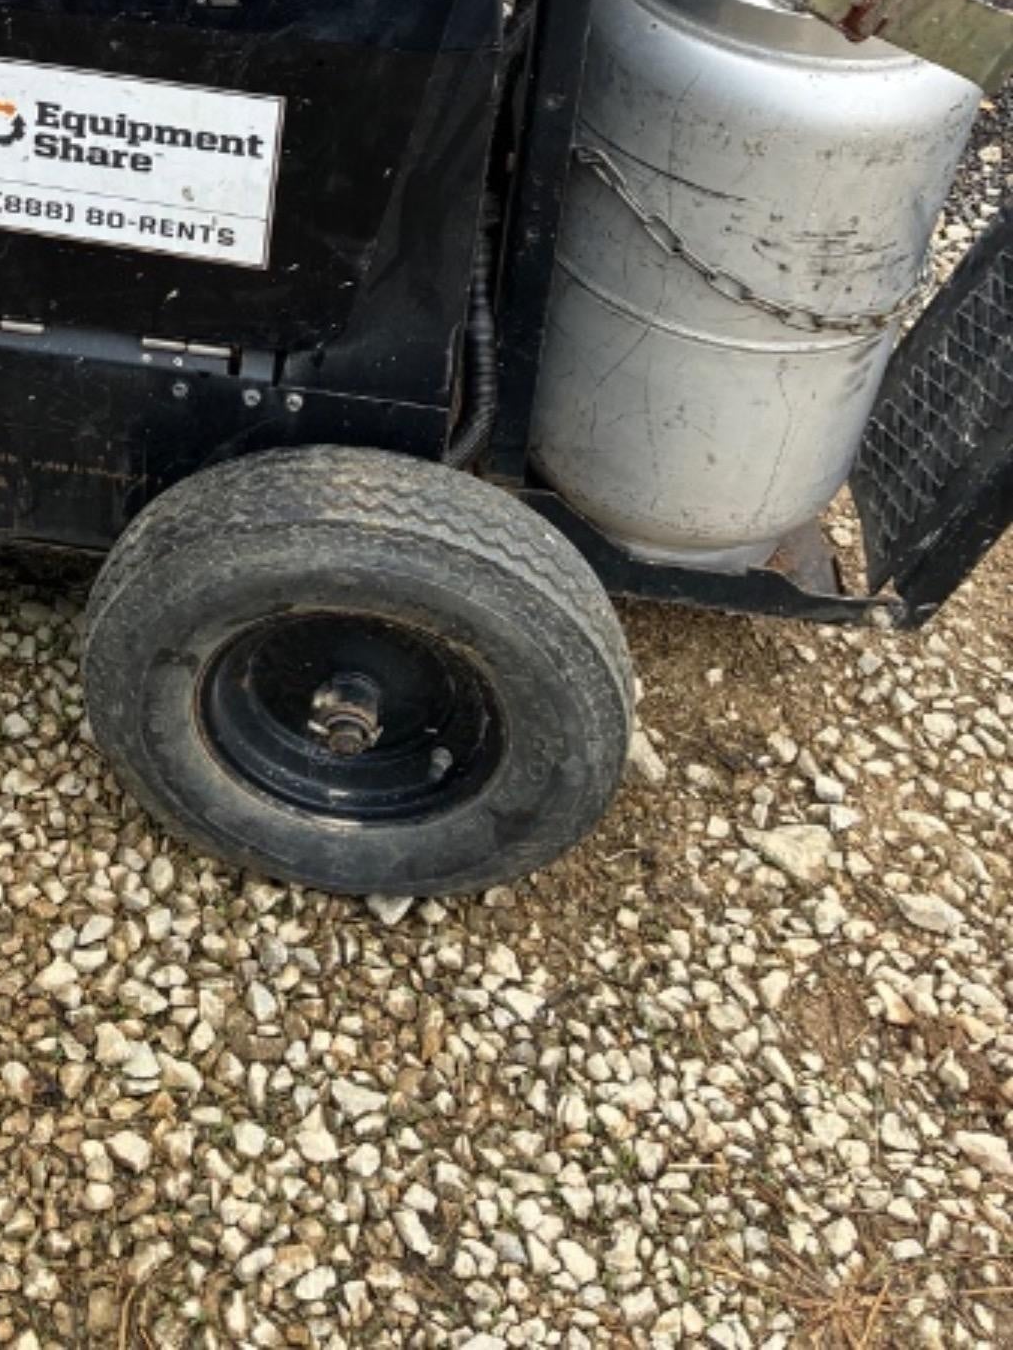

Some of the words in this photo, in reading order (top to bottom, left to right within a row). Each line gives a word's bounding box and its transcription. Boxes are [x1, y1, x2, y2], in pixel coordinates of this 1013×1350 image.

[34, 101, 265, 159] Equipment
[33, 134, 153, 173] Share
[86, 209, 236, 247] 80-RENTS
